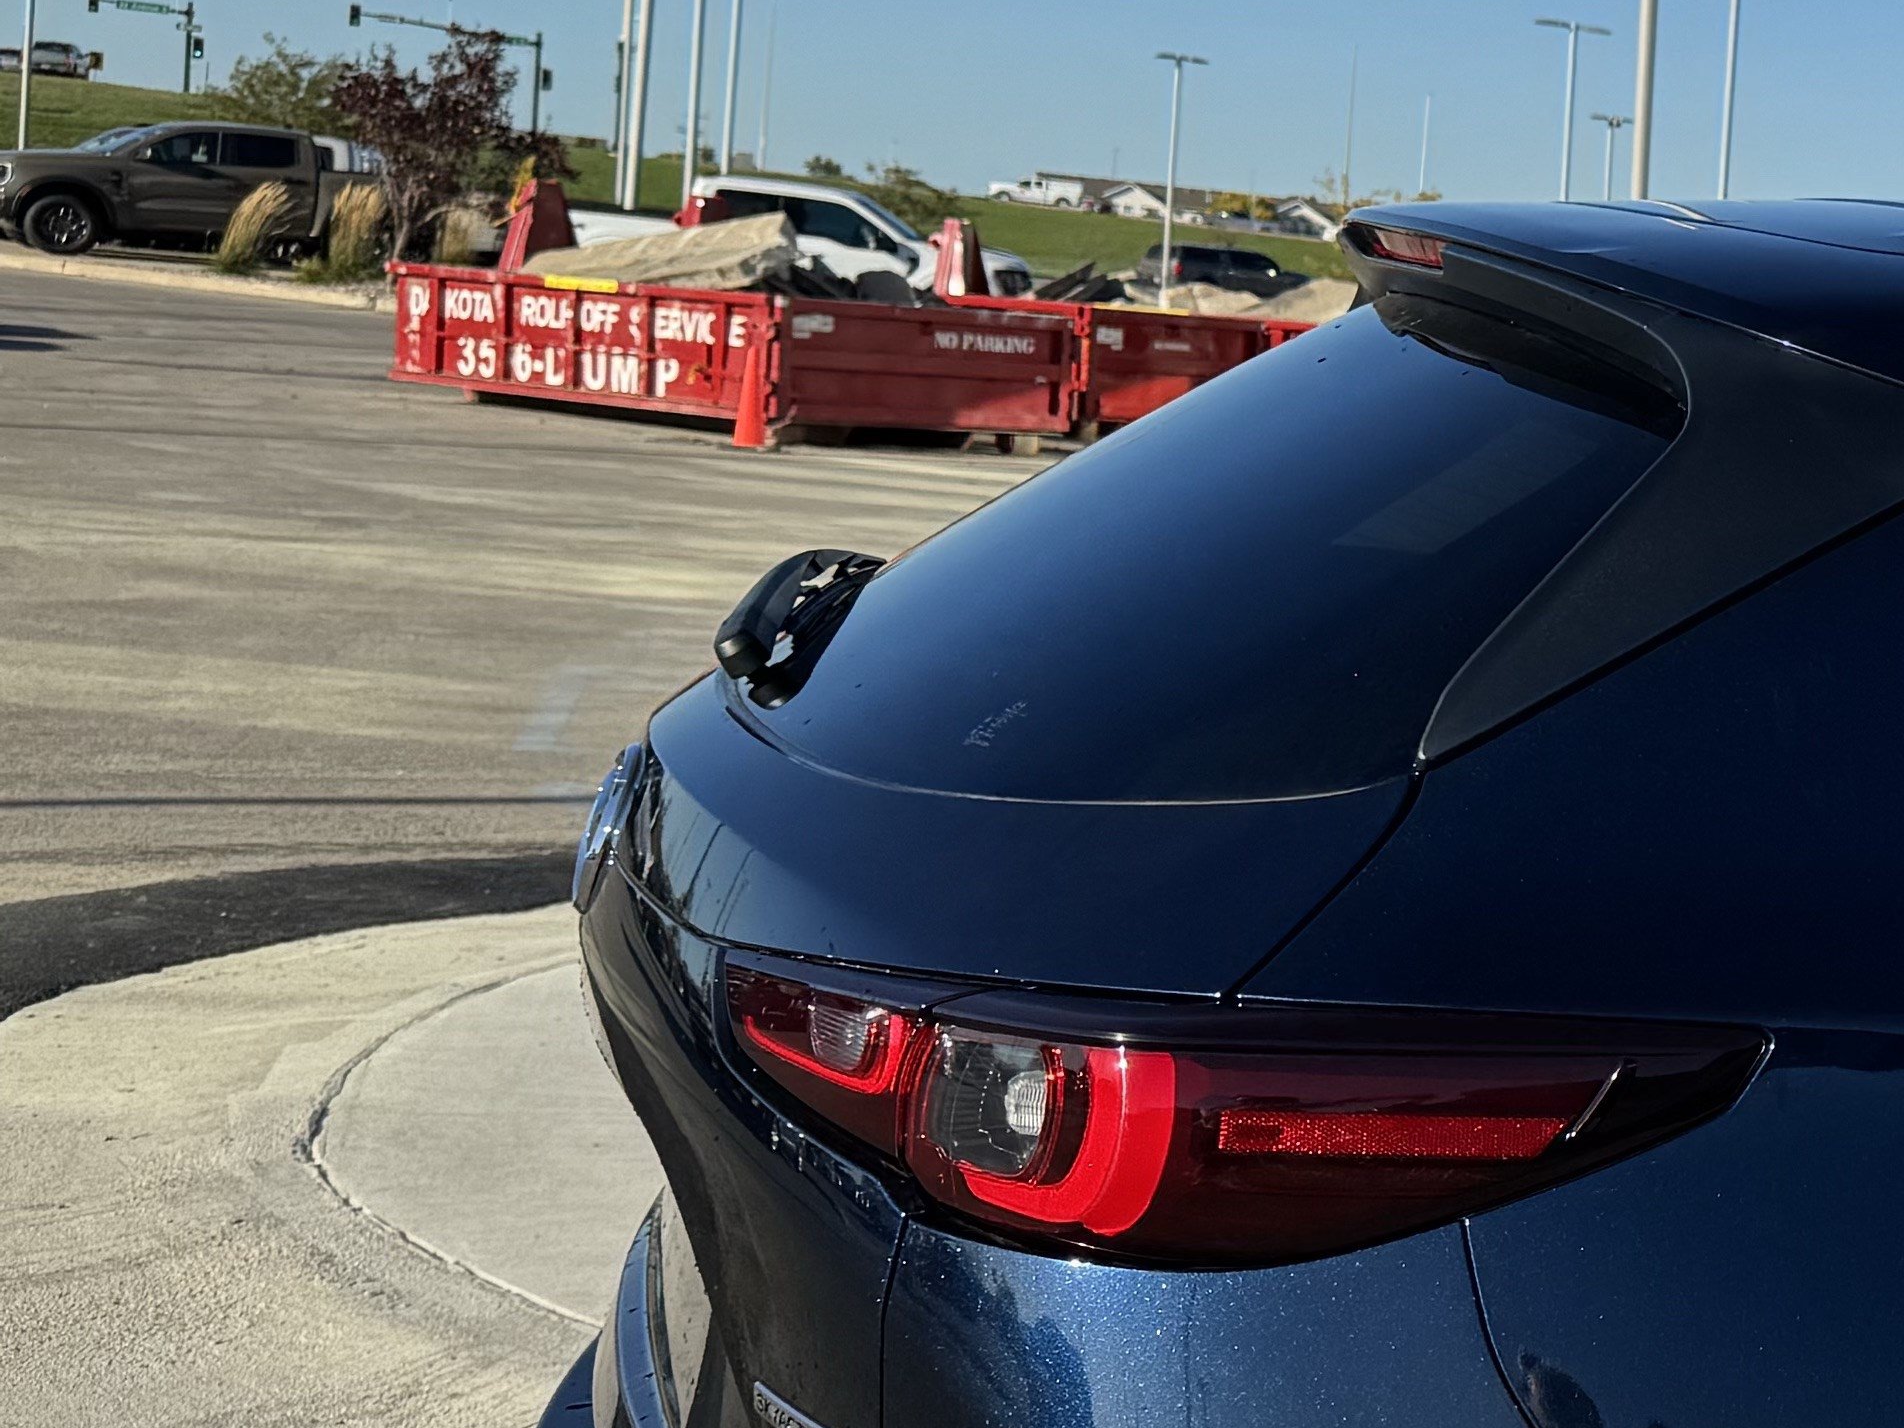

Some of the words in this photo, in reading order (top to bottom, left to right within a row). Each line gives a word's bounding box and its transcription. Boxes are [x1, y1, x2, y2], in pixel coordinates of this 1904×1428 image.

[629, 306, 749, 348] SERVICE
[934, 331, 957, 349] NO
[962, 333, 1036, 354] PARKING
